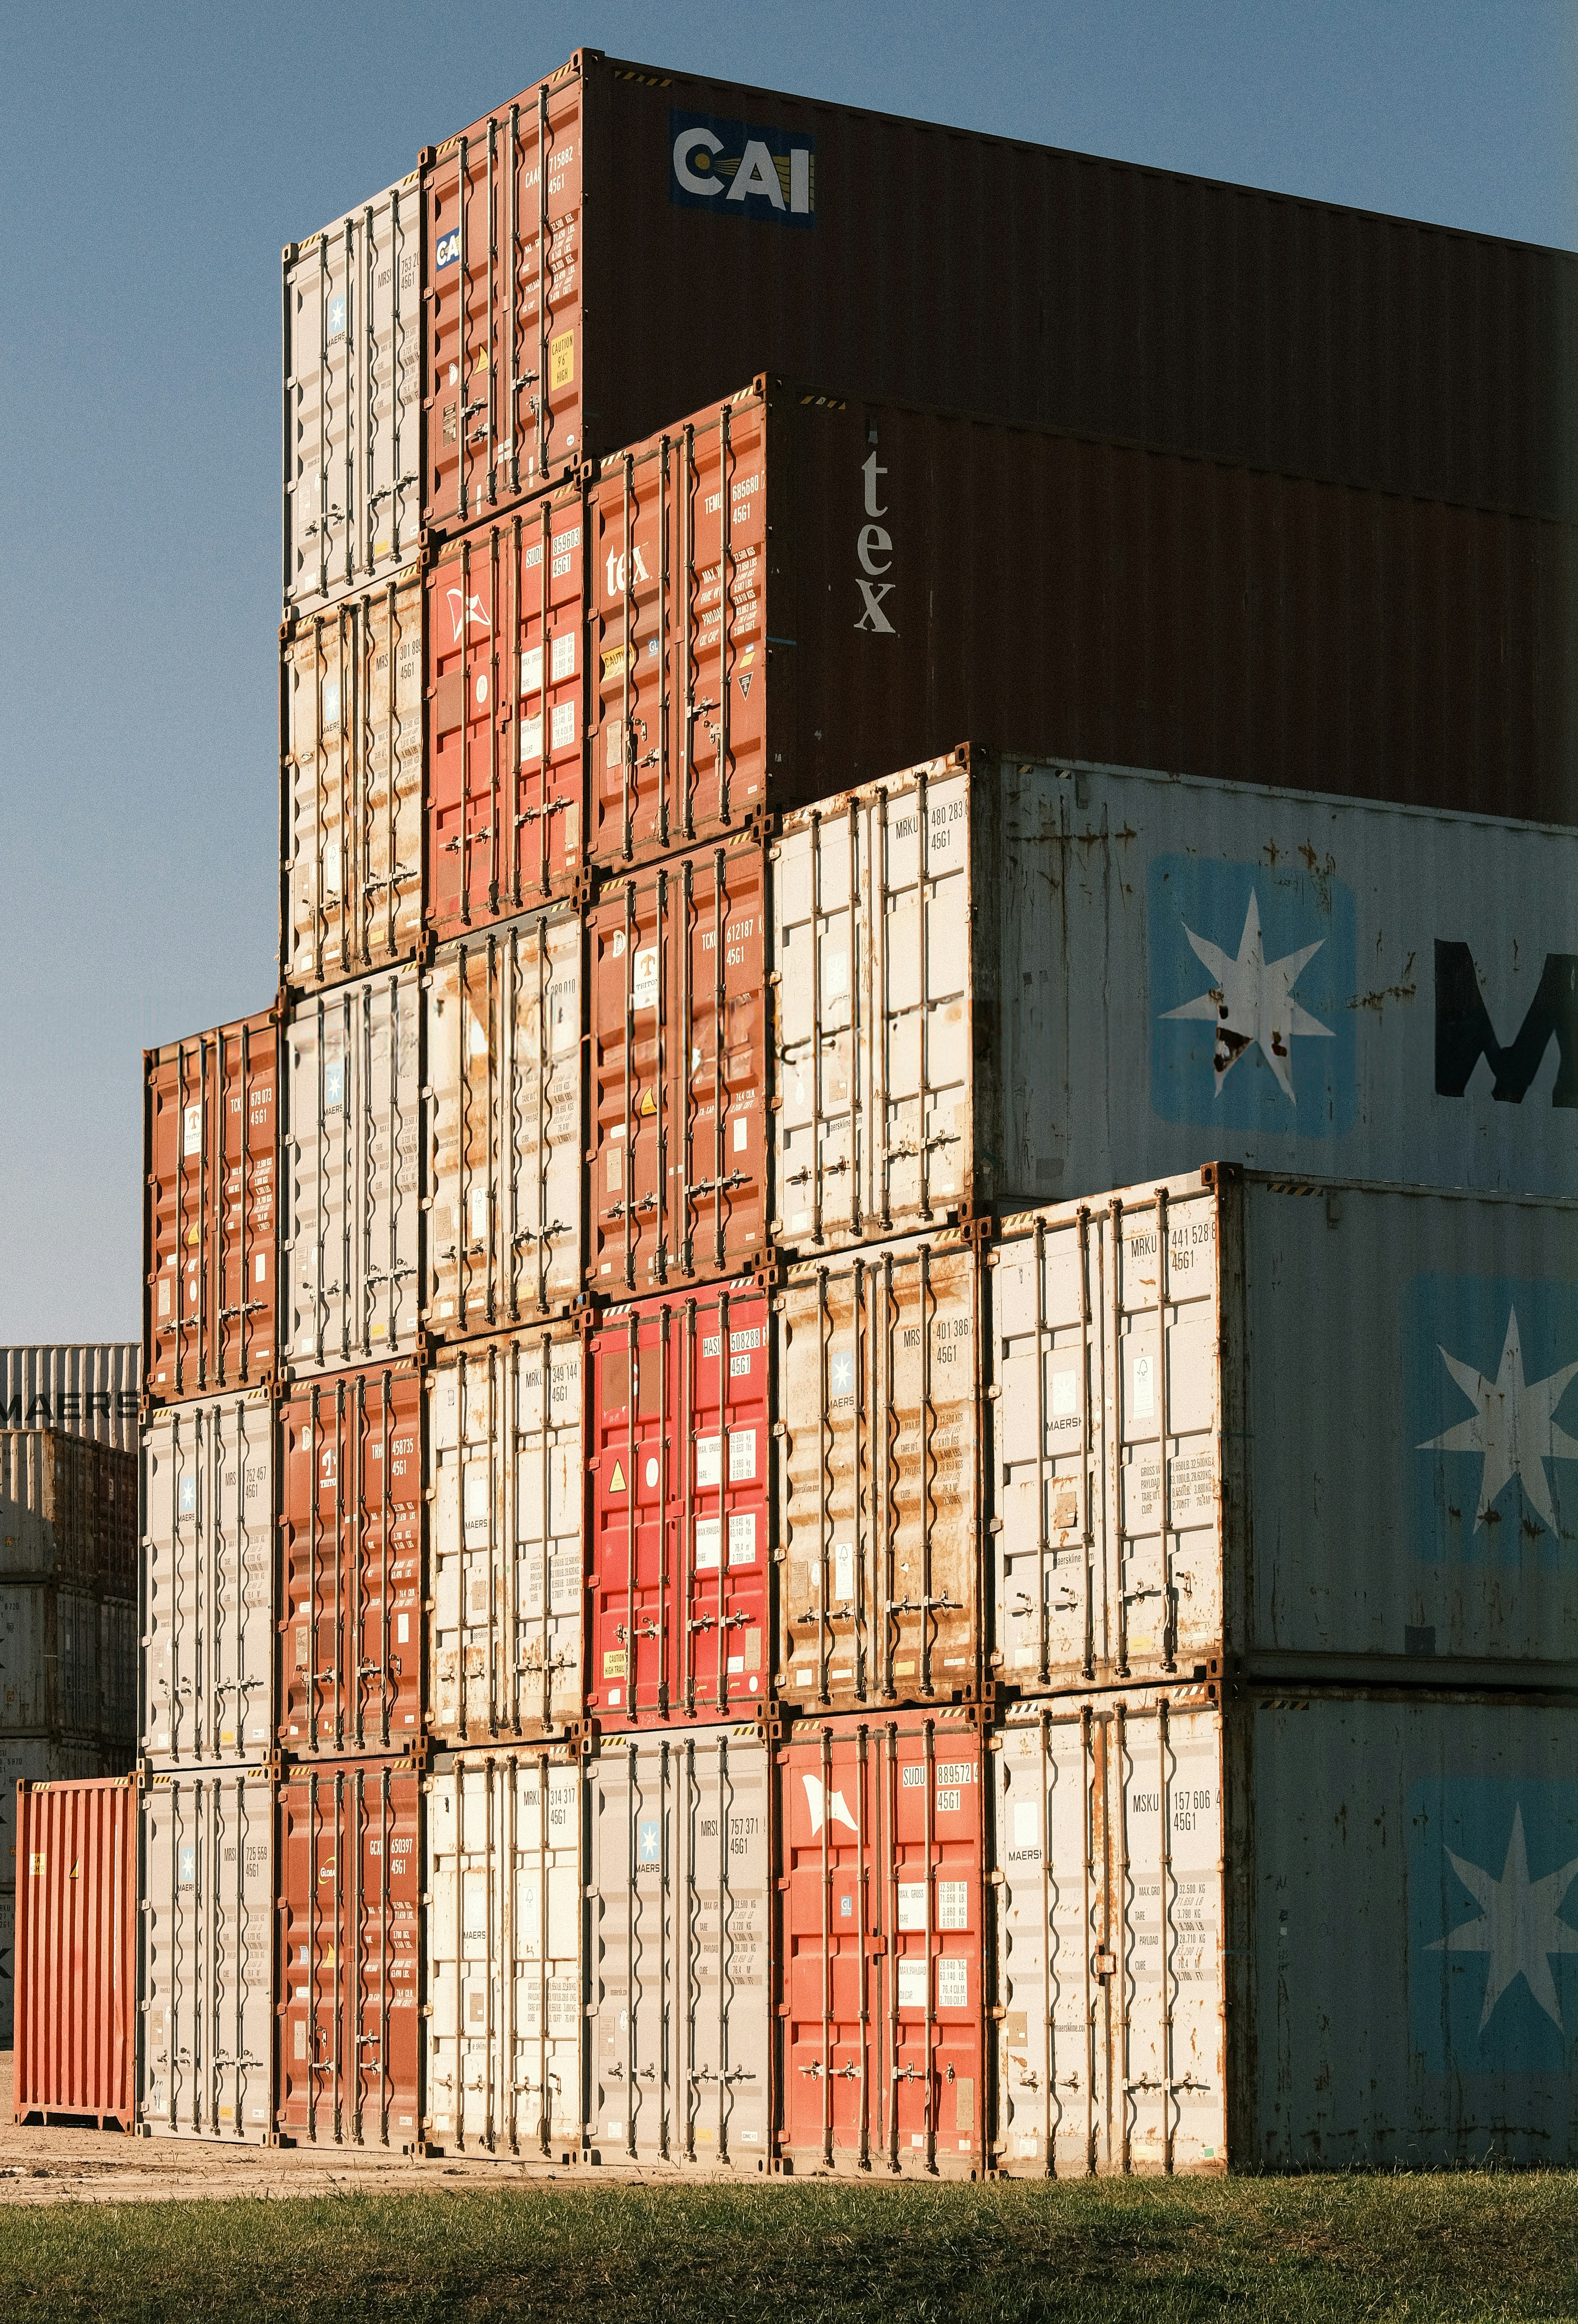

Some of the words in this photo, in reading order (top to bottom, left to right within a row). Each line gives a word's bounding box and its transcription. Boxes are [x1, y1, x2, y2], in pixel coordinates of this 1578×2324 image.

[549, 146, 565, 174] 715882
[673, 128, 809, 214] CAI
[548, 173, 564, 195] 45G1
[437, 228, 460, 265] CA
[402, 259, 411, 275] 753
[401, 273, 415, 290] 45G1
[326, 333, 345, 349] MAERS
[552, 335, 573, 355] CAUTION
[557, 368, 568, 383] HIGH
[704, 492, 721, 515] TEMU
[733, 475, 759, 502] 685680
[733, 503, 750, 524] 45G1
[554, 529, 579, 554] 859603
[854, 451, 896, 633] tex
[553, 555, 569, 575] 45G1
[606, 545, 650, 597] tex
[702, 568, 716, 584] MAX.
[702, 607, 721, 626] PAYLOA
[649, 640, 658, 652] GL
[376, 653, 388, 671] MRS
[400, 645, 410, 660] 301
[605, 647, 632, 668] CAUTIN
[400, 661, 414, 680] 45G1
[323, 721, 339, 735] MAERS
[896, 817, 918, 839] MRKU
[932, 808, 945, 826] 480
[949, 802, 962, 820] 283
[932, 830, 950, 850] 45G1
[727, 919, 753, 943] 612187
[727, 946, 744, 966] 45G1
[1435, 938, 1578, 1108] M
[230, 1099, 241, 1113] TCK
[251, 1092, 261, 1107] 679
[262, 1088, 272, 1103] 073
[251, 1108, 266, 1126] 45G1
[324, 1105, 343, 1117] MAERS
[827, 1115, 862, 1133] maersklineom
[1131, 1235, 1157, 1257] MRKU
[1172, 1228, 1188, 1248] 441
[1192, 1224, 1208, 1244] 528
[1172, 1250, 1194, 1271] 45G1
[904, 1329, 920, 1348] MRS
[936, 1322, 951, 1340] 401
[954, 1319, 968, 1337] 386
[731, 1334, 759, 1351] 508288
[937, 1345, 956, 1364] 45G1
[553, 1367, 564, 1383] 349
[567, 1363, 577, 1379] 144
[731, 1357, 750, 1375] 45G1
[552, 1386, 567, 1402] 45G1
[0, 1392, 142, 1421] MAERS
[829, 1396, 854, 1409] MAERS
[731, 1435, 744, 1443] 32.500
[372, 1443, 382, 1460] TRH
[392, 1437, 414, 1456] 458735
[731, 1444, 744, 1453] 71.650
[392, 1460, 406, 1476] 45G1
[698, 1470, 707, 1480] TARE
[1141, 1467, 1154, 1477] GROSS
[225, 1472, 236, 1487] MRS
[246, 1469, 255, 1483] 752
[257, 1466, 266, 1480] 457
[320, 1479, 336, 1488] TRITO
[246, 1484, 258, 1499] 45G1
[1141, 1480, 1160, 1490] PAYLOAD
[1142, 1505, 1152, 1514] CUBE
[178, 1513, 195, 1523] MAERS
[465, 1519, 488, 1530] MAERS
[1053, 1554, 1094, 1569] maerskline.m
[609, 1653, 624, 1662] CAUTION
[904, 1767, 925, 1785] SUDU
[938, 1765, 970, 1783] 889572
[551, 1789, 562, 1805] 314
[564, 1788, 575, 1804] 317
[938, 1792, 959, 1809] 45G1
[1133, 1794, 1159, 1812] MSKU
[1174, 1792, 1190, 1810] 157
[1194, 1790, 1210, 1809] 606
[551, 1810, 566, 1825] 45G1
[1174, 1813, 1196, 1831] 45G1
[731, 1819, 743, 1835] 757
[746, 1818, 758, 1834] 371
[246, 1848, 256, 1861] 725
[258, 1847, 267, 1860] 559
[391, 1839, 413, 1854] 650397
[730, 1838, 747, 1854] 45G1
[246, 1864, 259, 1877] 45G1
[320, 1867, 335, 1878] GLOBA
[391, 1859, 406, 1874] 45G1
[636, 1864, 659, 1873] MAERS
[899, 1889, 909, 1898] MAX.
[911, 1888, 923, 1897] GROSS
[940, 1883, 955, 1892] 32.500
[1179, 1885, 1196, 1894] 32.500
[1199, 1884, 1205, 1893] KG
[842, 1899, 851, 1911] GL
[940, 1893, 955, 1903] 71.650
[943, 1907, 955, 1916] 3.860
[1135, 1911, 1145, 1920] TARE
[1178, 1910, 1191, 1919] 3.790
[1194, 1909, 1201, 1918] KG
[899, 1915, 908, 1923] TARE
[943, 1918, 955, 1927] 8.510
[1196, 1922, 1204, 1930] LB
[463, 1931, 486, 1940] MAERS
[1139, 1936, 1158, 1945] PAYLOAD
[1179, 1935, 1195, 1944] 28.710
[1199, 1934, 1205, 1943] KG
[940, 1961, 954, 1970] 28.640
[1135, 1961, 1145, 1970] CUBE
[1178, 1959, 1188, 1968] 76.4
[940, 1971, 955, 1980] 63.140
[1177, 1971, 1192, 1981] 2.700
[942, 1985, 952, 1994] 76.4
[954, 1984, 966, 1993] CU.M.
[940, 1995, 953, 2004] 2.700
[953, 1995, 967, 2004] CU.FT.
